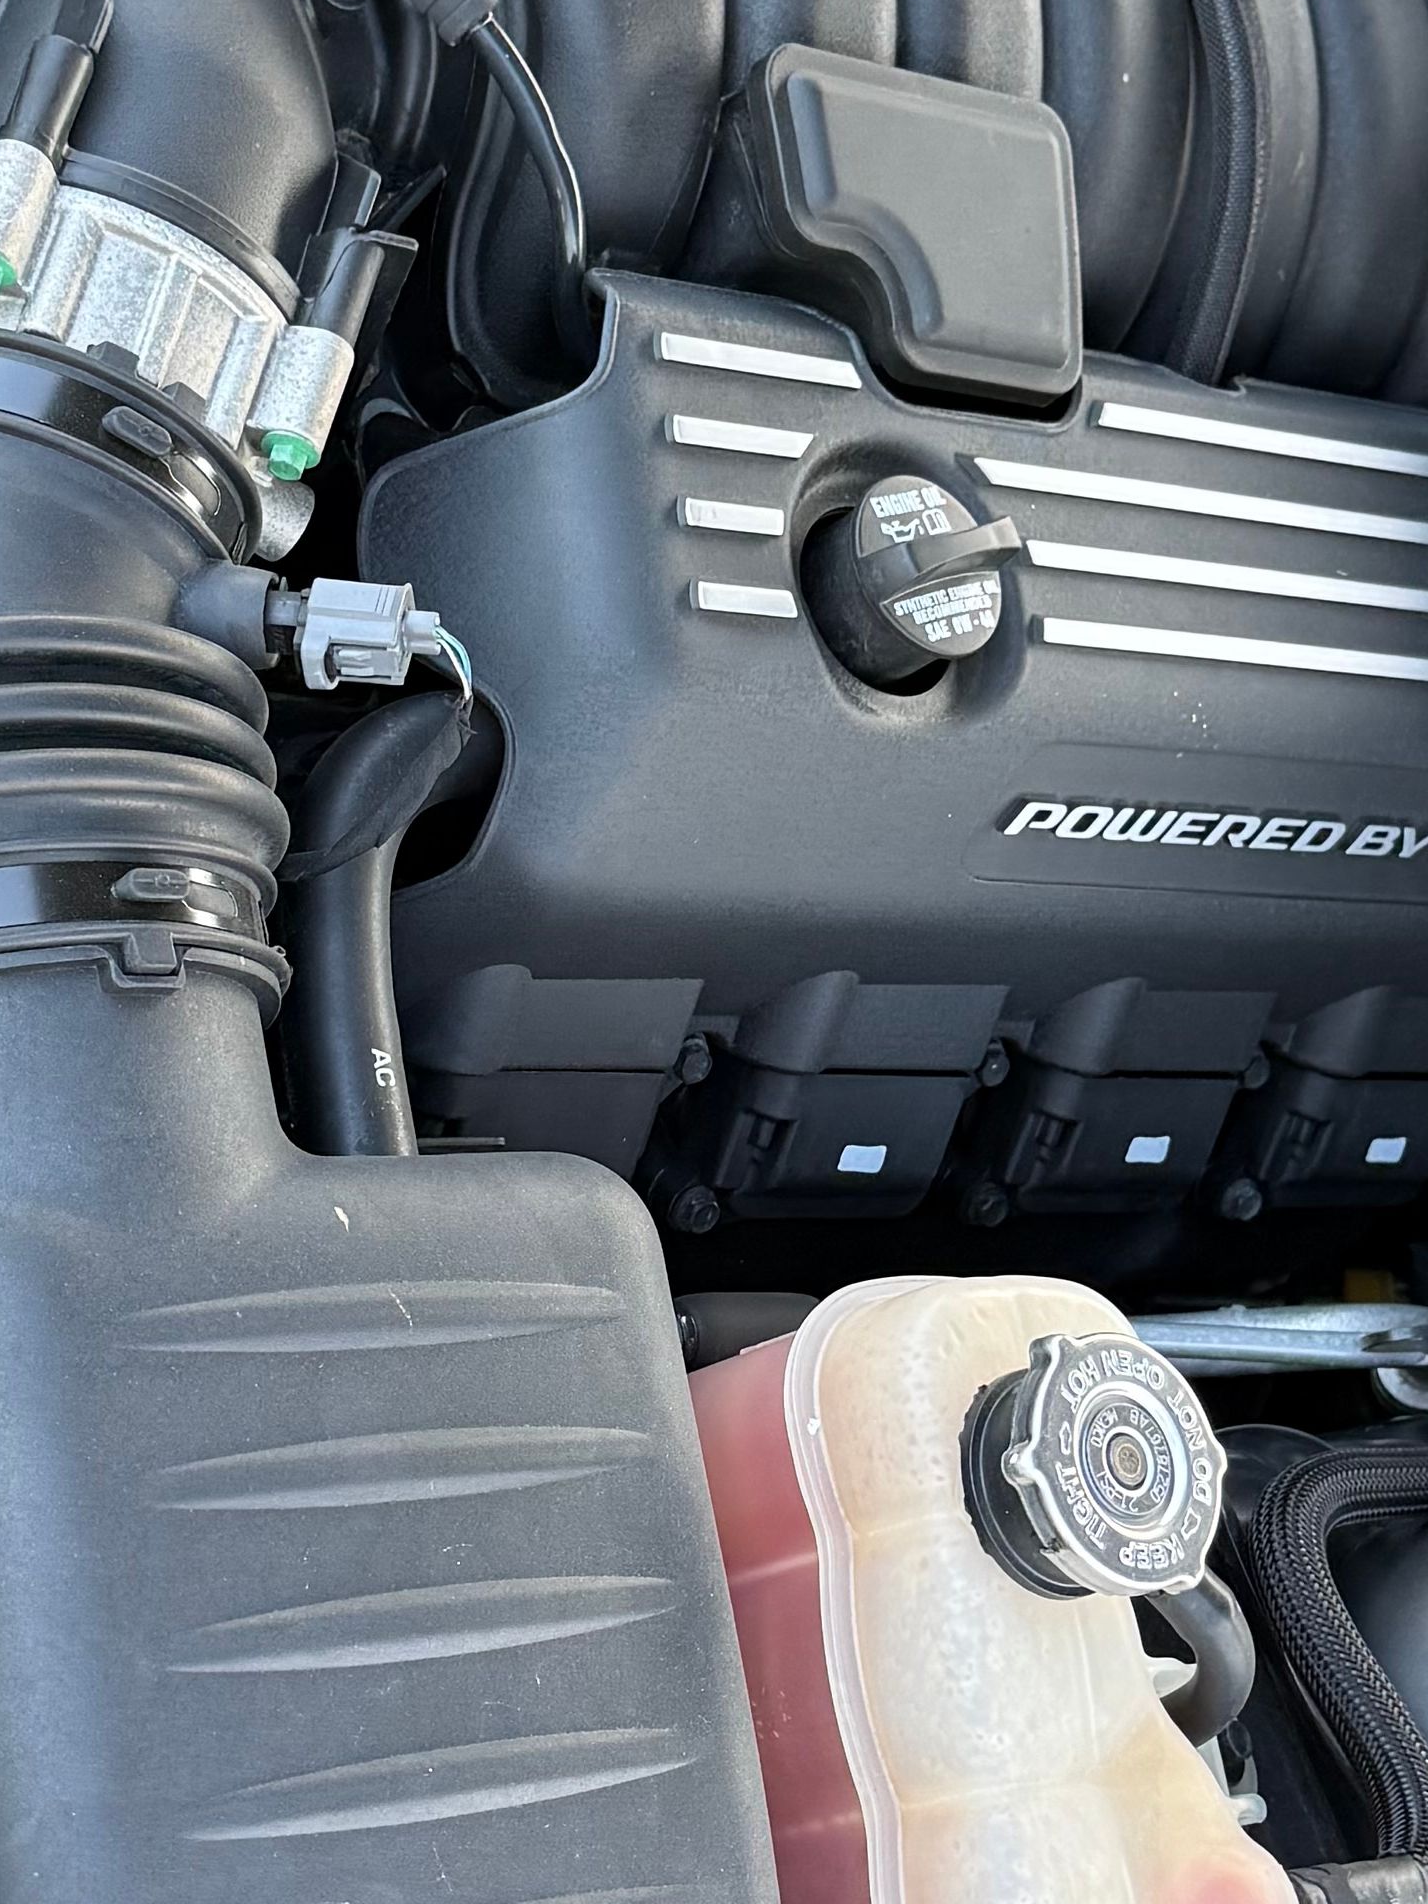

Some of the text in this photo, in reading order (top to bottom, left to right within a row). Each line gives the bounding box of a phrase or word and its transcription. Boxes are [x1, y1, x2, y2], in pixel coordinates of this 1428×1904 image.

[869, 485, 948, 518] ENGINE OIL
[893, 589, 949, 616] SYNTHETIC
[924, 619, 952, 643] SAE
[1003, 800, 1348, 854] POWERED
[371, 1048, 396, 1087] AC
[1060, 1349, 1212, 1506] DO NOT OPEN HOT
[1055, 1461, 1185, 1570] KEEP TIGHT
